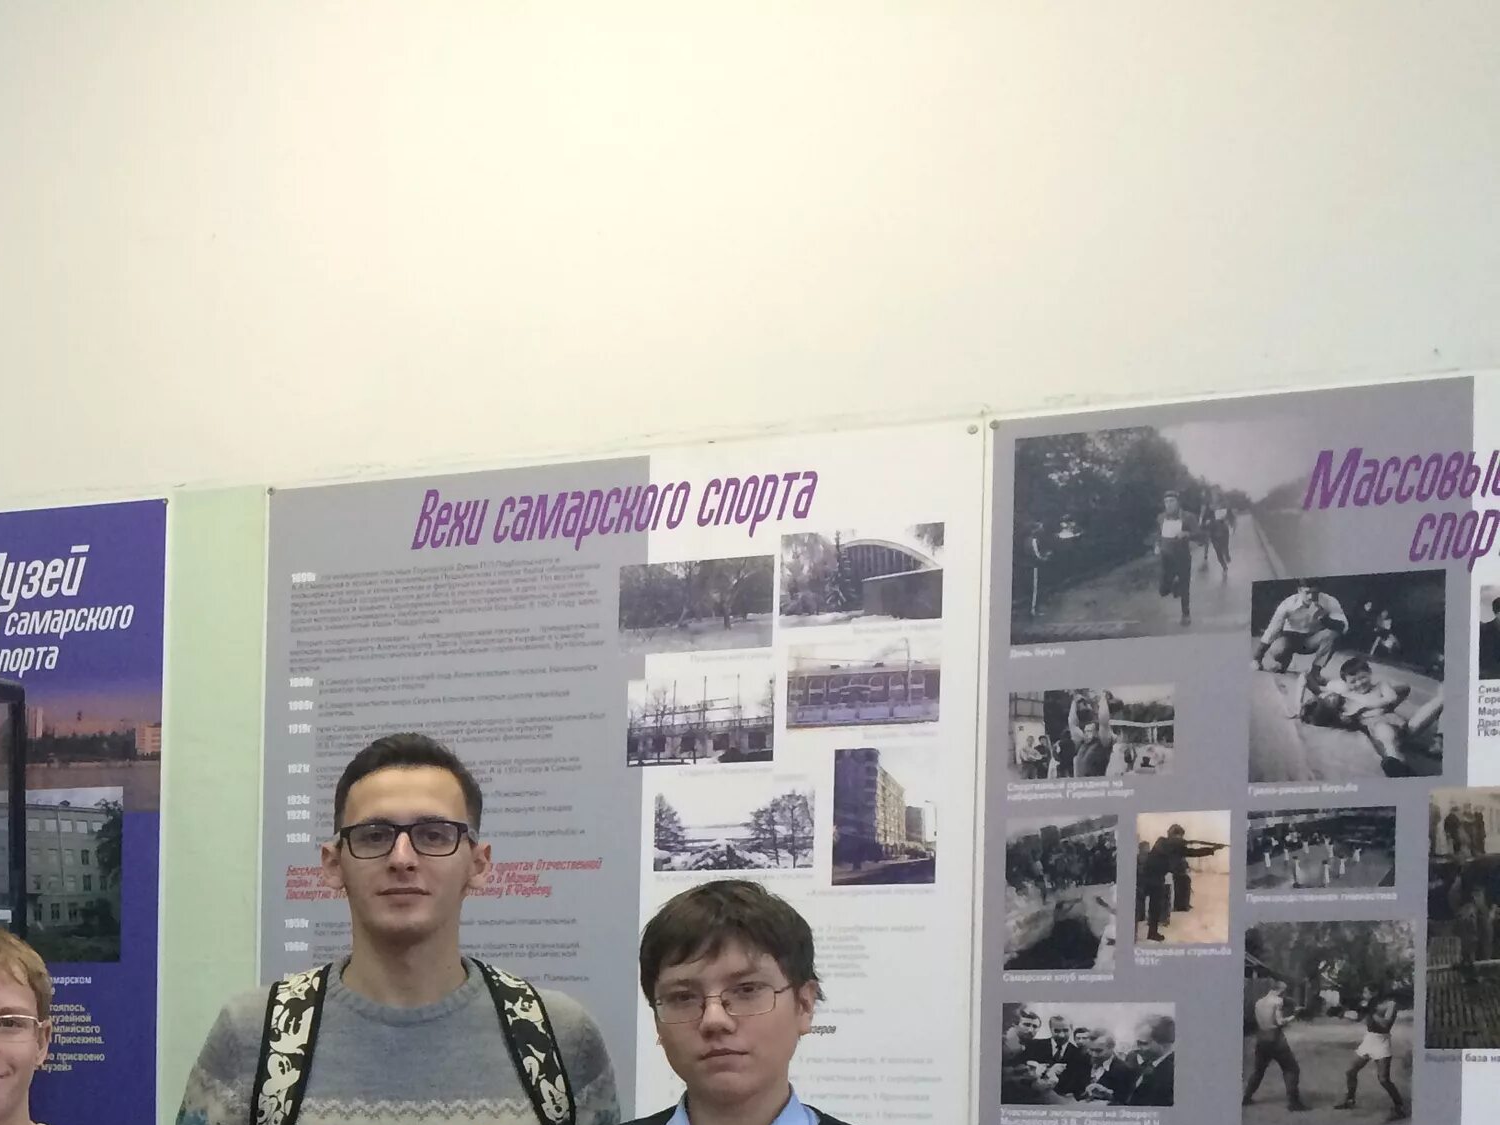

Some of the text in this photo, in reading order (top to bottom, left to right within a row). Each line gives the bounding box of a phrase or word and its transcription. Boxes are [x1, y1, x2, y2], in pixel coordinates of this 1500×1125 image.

[411, 471, 818, 551] Вехи самарского спорта
[4, 604, 134, 640] самарского
[51, 1024, 100, 1034] мпийского
